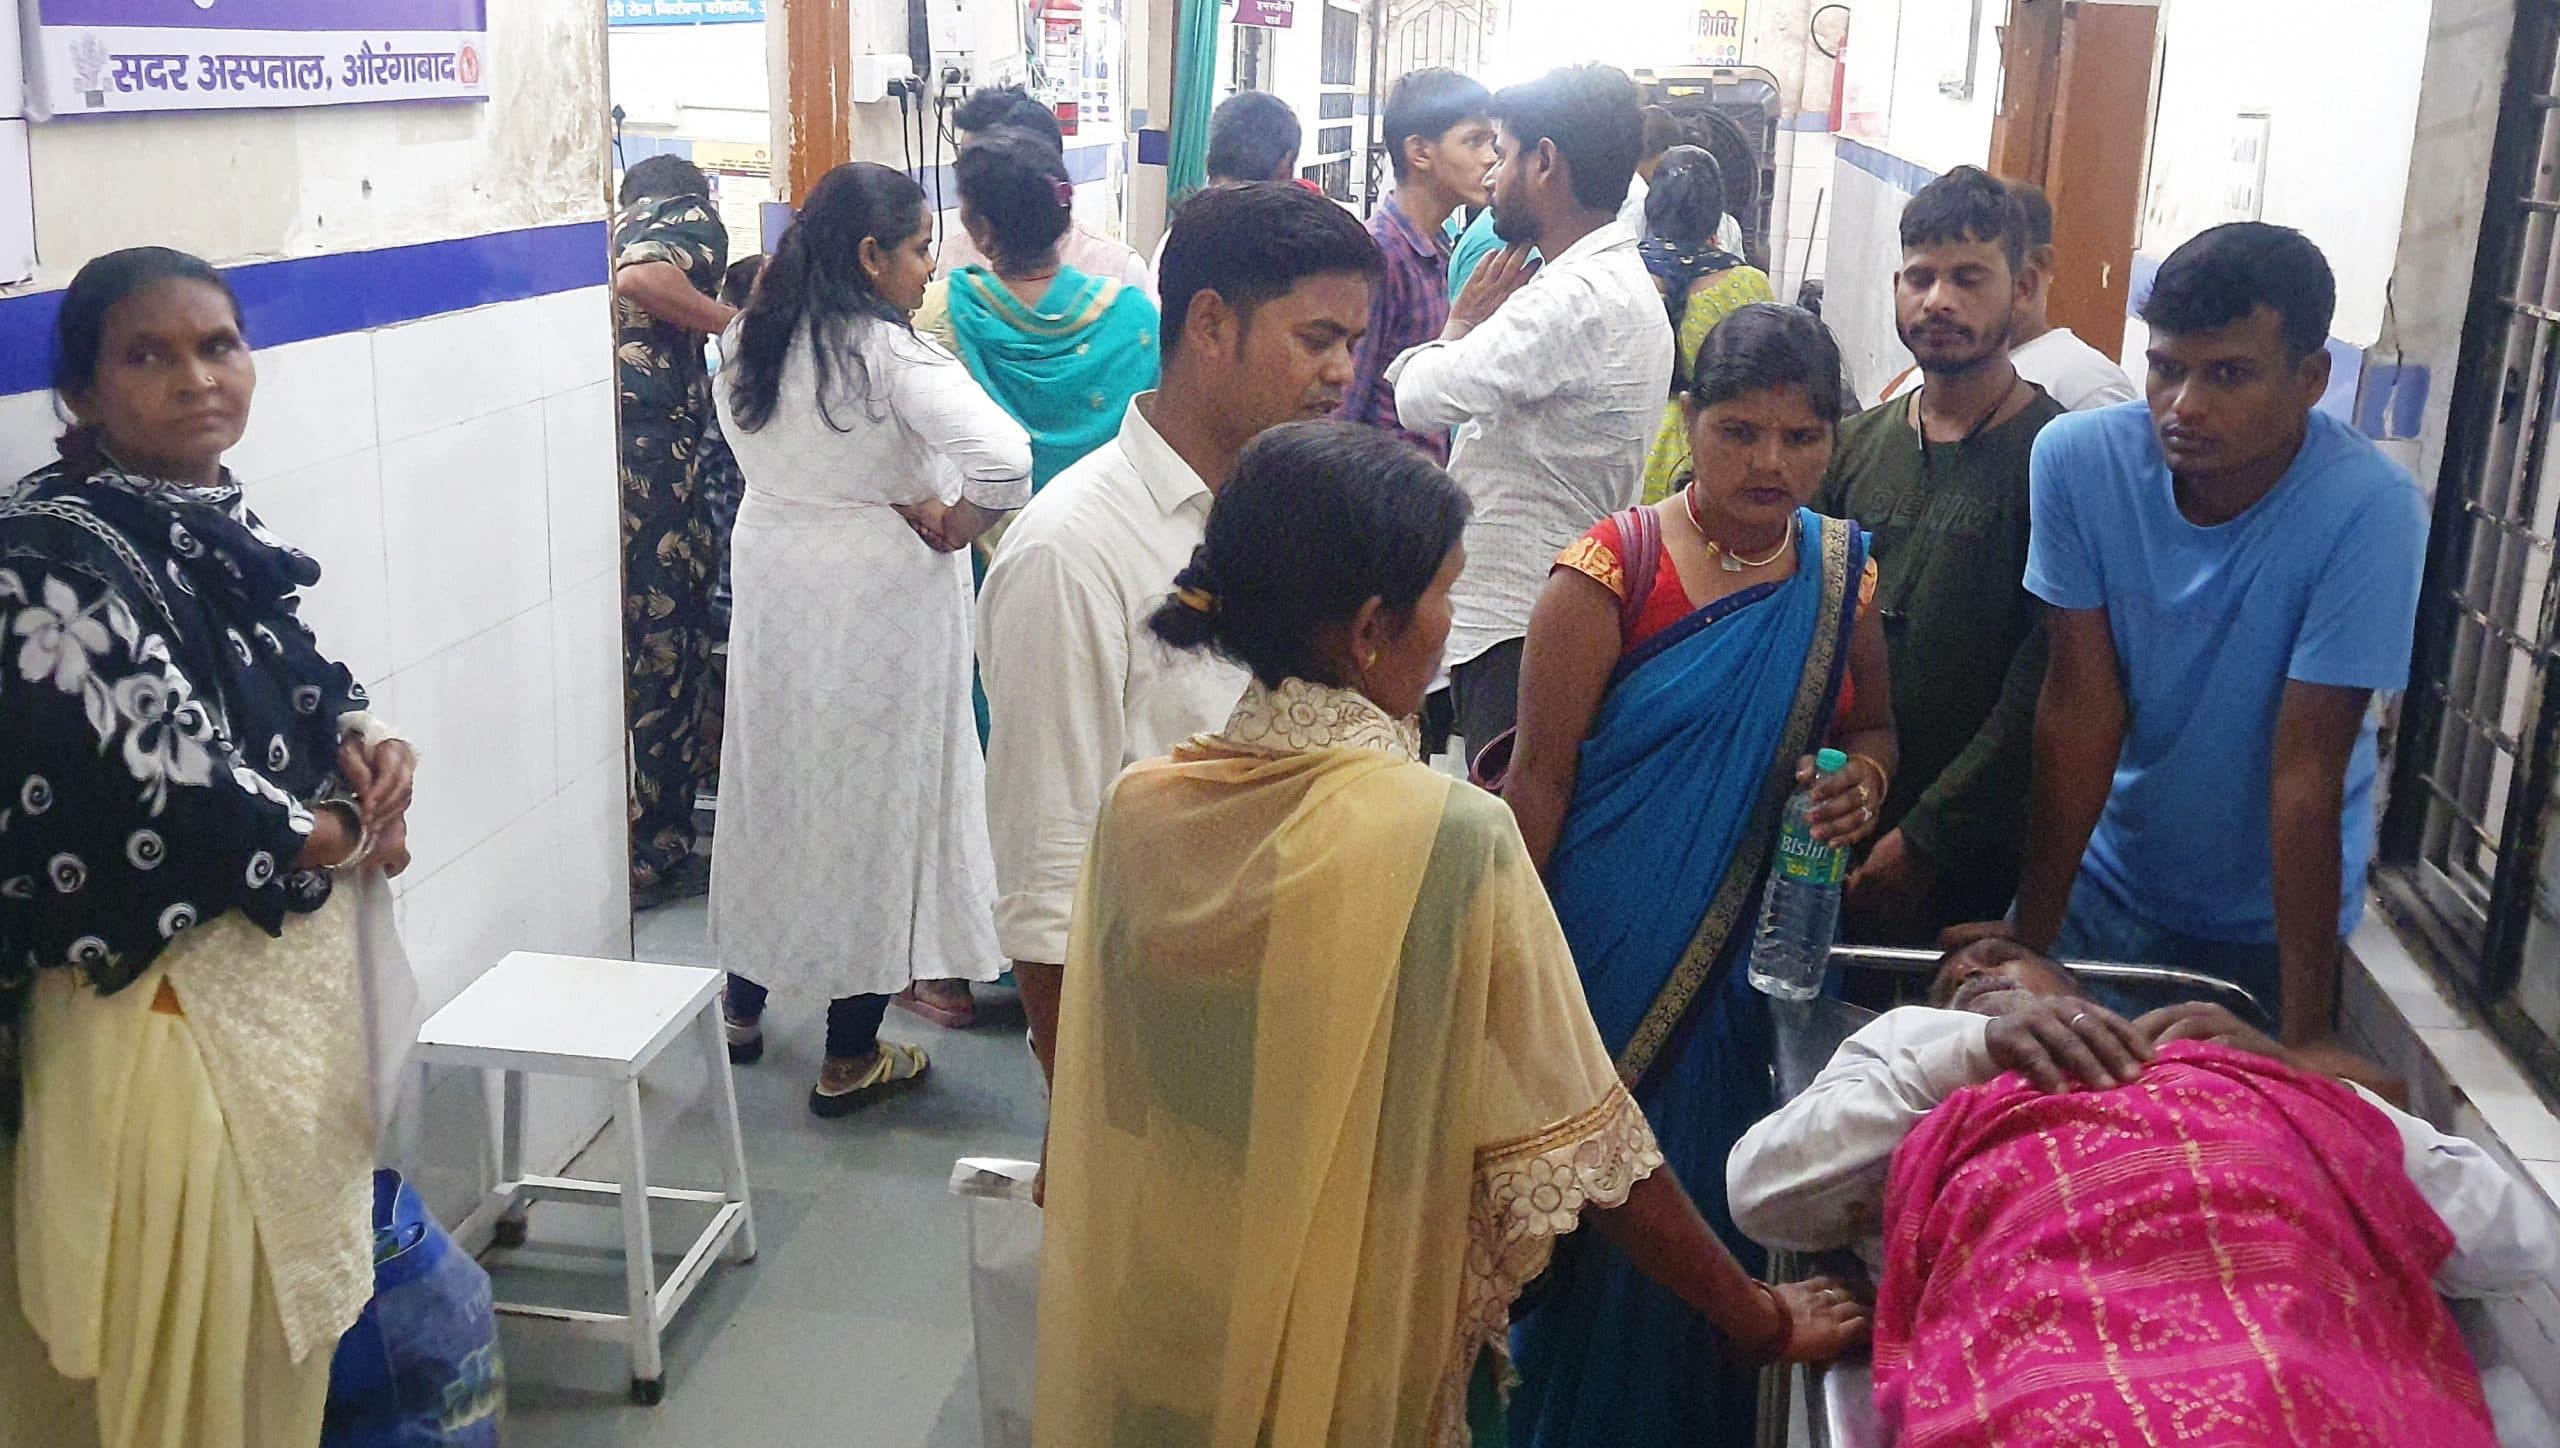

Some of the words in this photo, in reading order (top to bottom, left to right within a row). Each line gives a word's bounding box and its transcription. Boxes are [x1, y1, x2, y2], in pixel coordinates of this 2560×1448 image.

[1698, 10, 1739, 37] शिविर
[109, 54, 189, 93] सदर
[197, 54, 333, 92] अस्पताल,
[342, 40, 456, 87] औरंगाबाद
